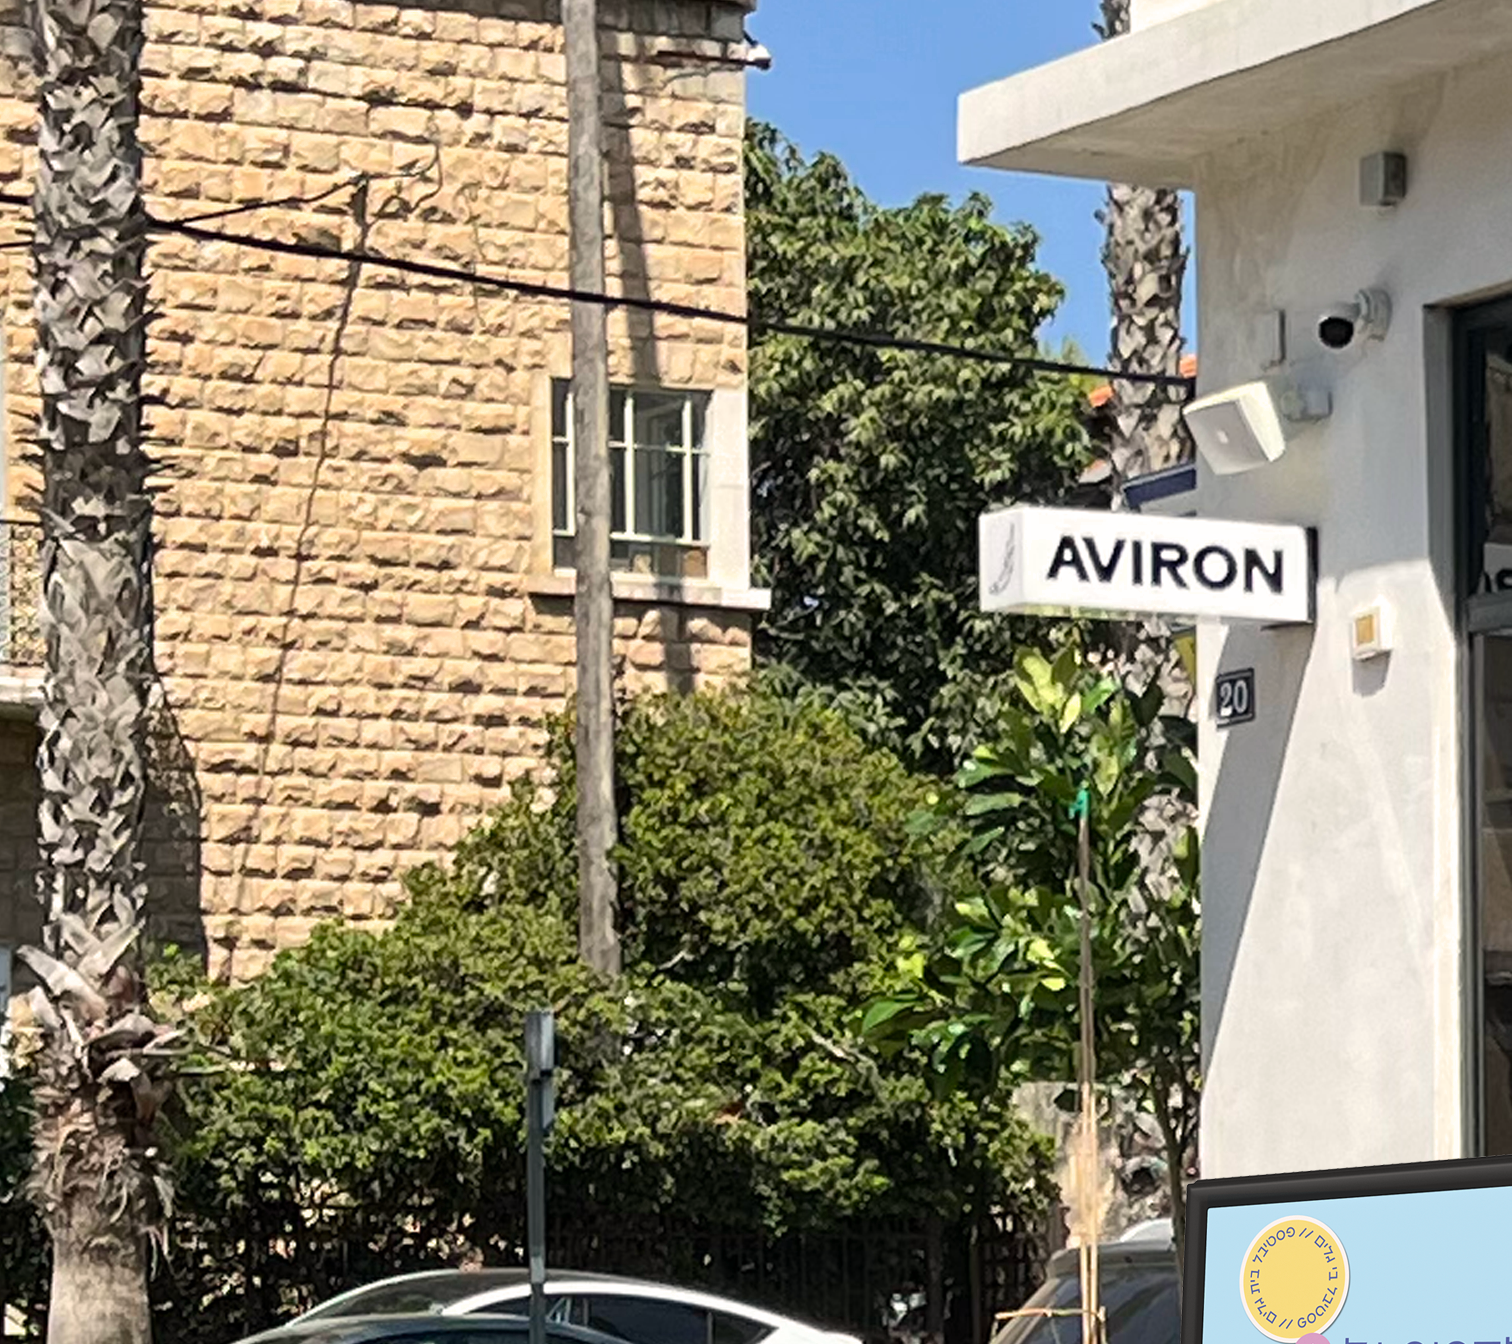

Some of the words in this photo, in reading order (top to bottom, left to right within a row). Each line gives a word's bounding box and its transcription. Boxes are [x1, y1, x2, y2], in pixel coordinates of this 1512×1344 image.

[1046, 535, 1284, 594] AVIRON
[1220, 680, 1248, 716] 20
[1251, 1226, 1296, 1263] פסטיבל
[1314, 1235, 1336, 1263] גלים
[1249, 1269, 1260, 1294] בית
[1254, 1297, 1277, 1324] גלים
[1297, 1287, 1338, 1328] פסטיבל
